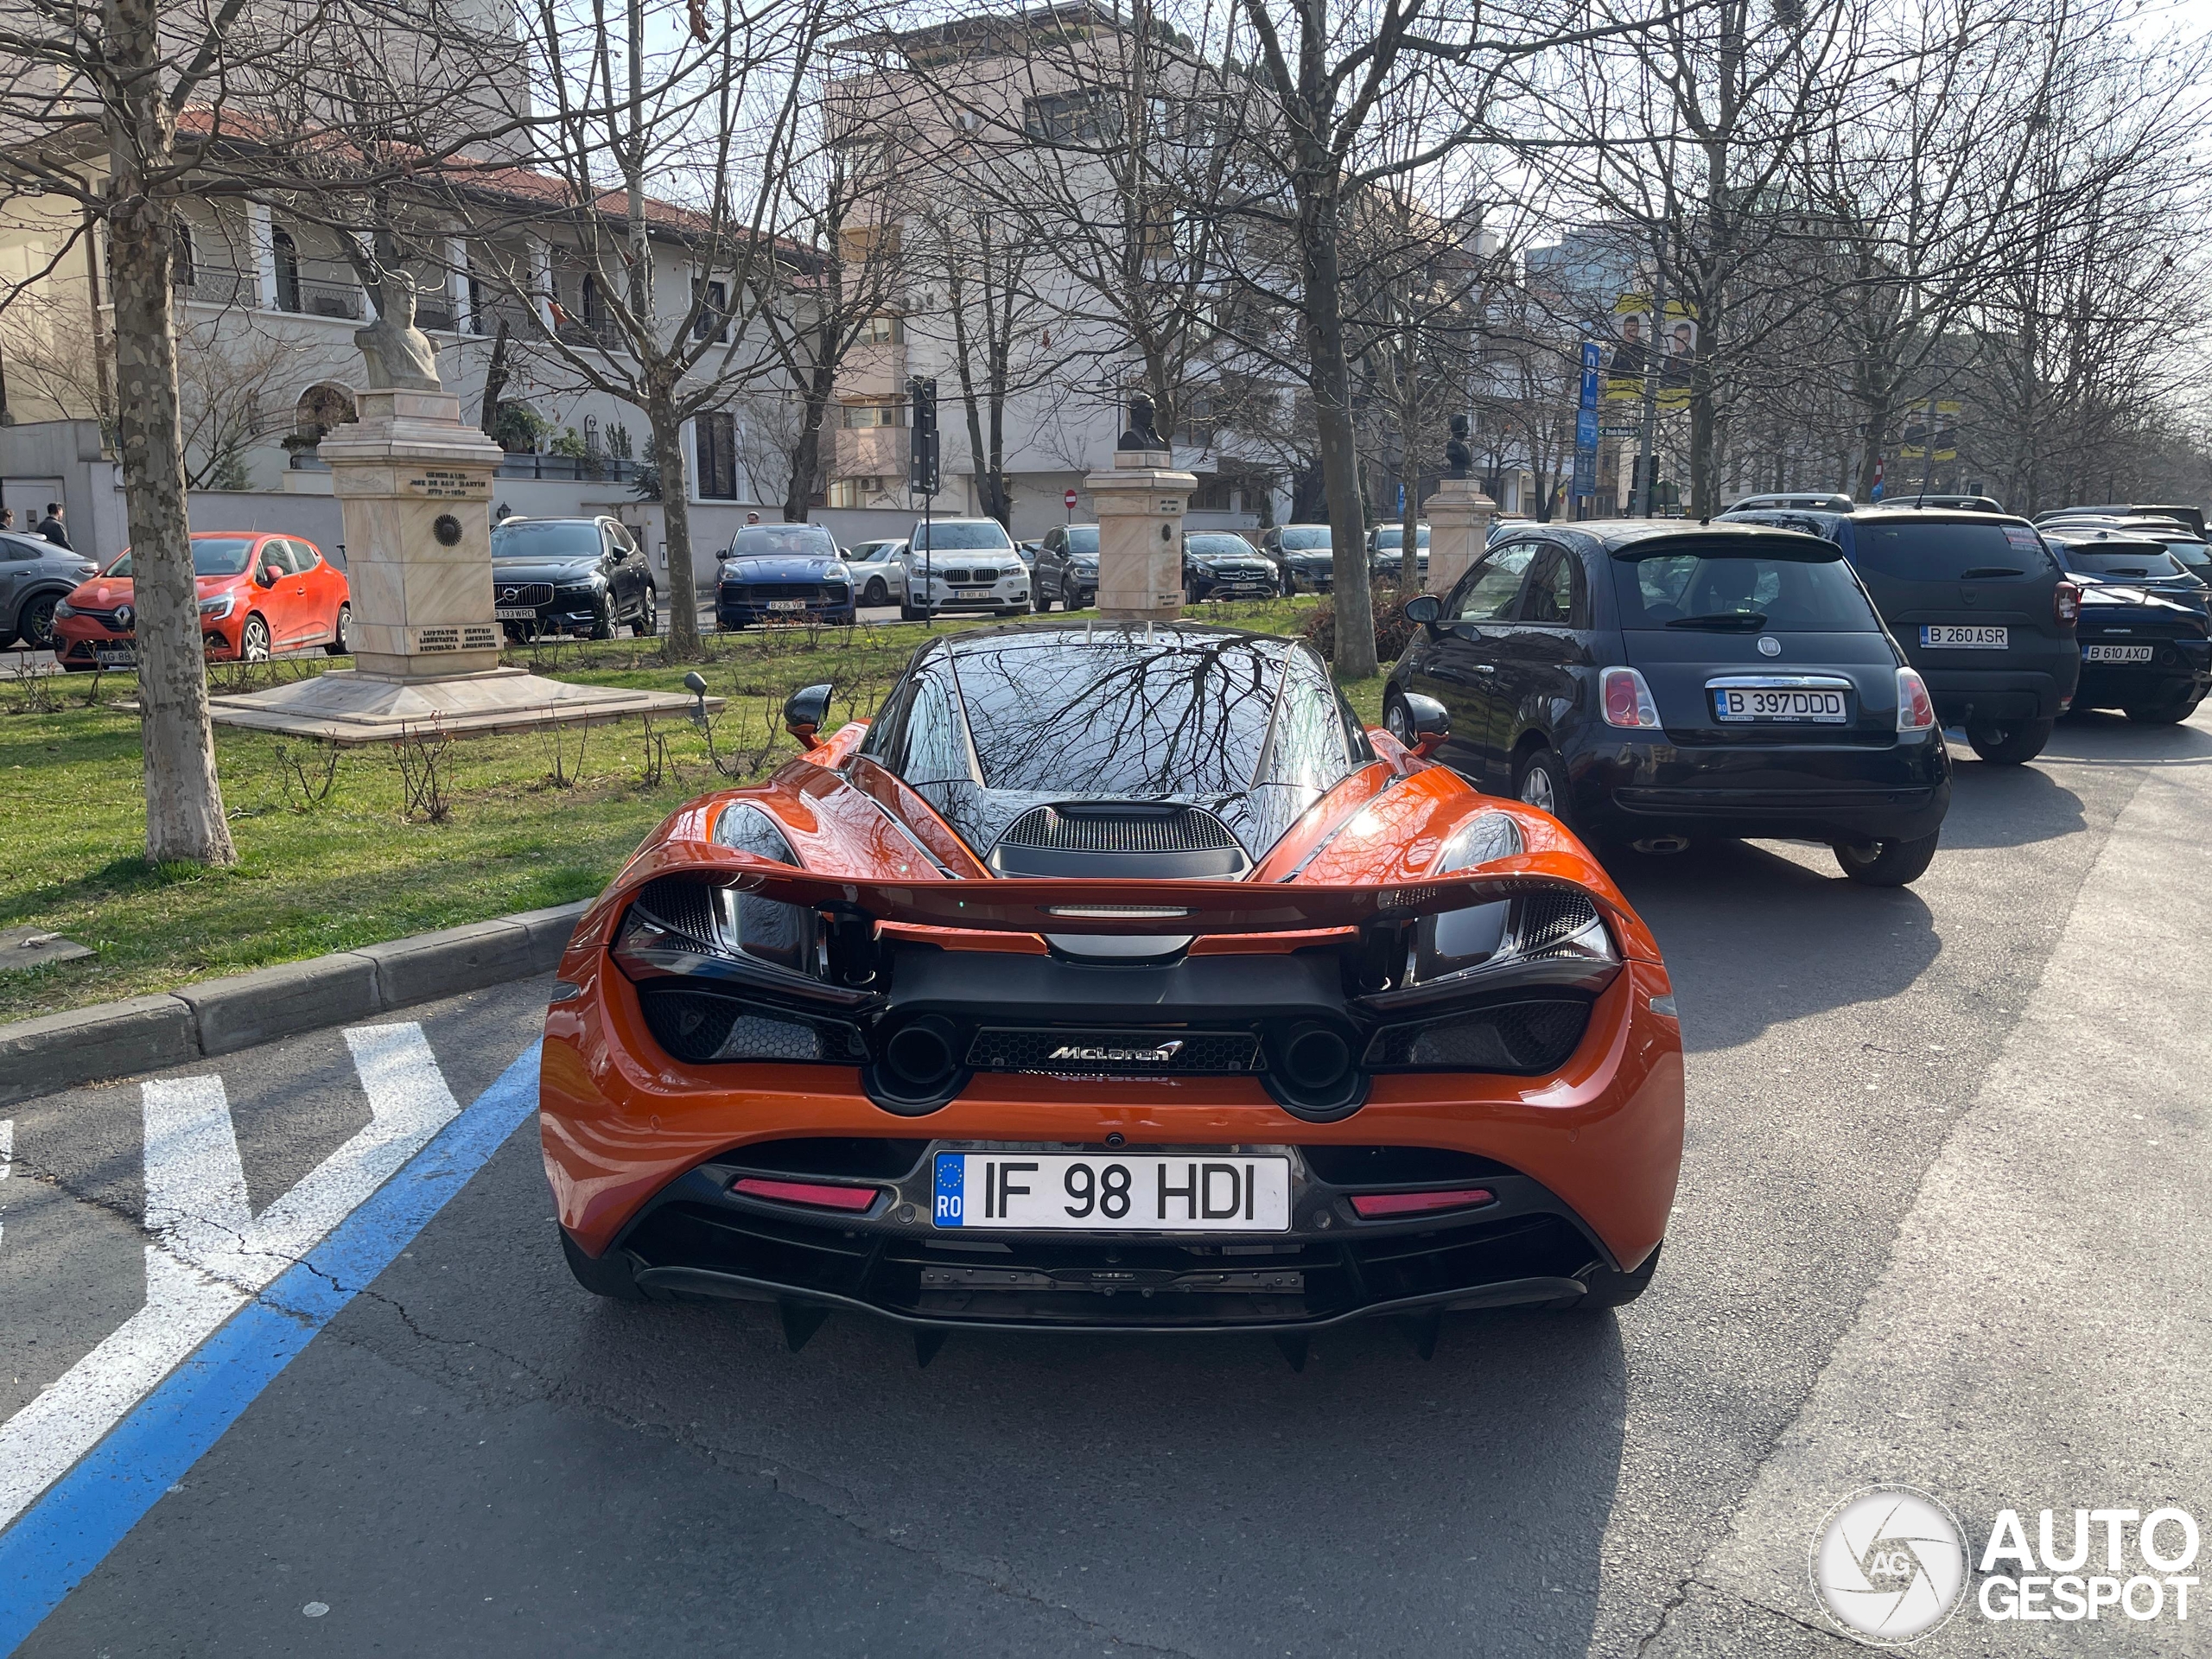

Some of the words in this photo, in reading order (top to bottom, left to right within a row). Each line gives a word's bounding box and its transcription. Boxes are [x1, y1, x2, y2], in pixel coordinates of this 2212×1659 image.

[1931, 627, 1942, 642] B
[1947, 628, 1973, 643] 260
[1976, 628, 2005, 643] ASR
[102, 652, 115, 662] AG
[2091, 647, 2101, 659] B
[2104, 647, 2123, 659] 610
[2125, 647, 2150, 659] AXD
[1717, 703, 1727, 713] RO
[1728, 693, 1745, 713] B
[1048, 1046, 1169, 1061] McLaren
[937, 1195, 962, 1218] RO
[985, 1162, 1039, 1218] IF
[1064, 1162, 1132, 1219] 98
[1157, 1163, 1255, 1220] HDI
